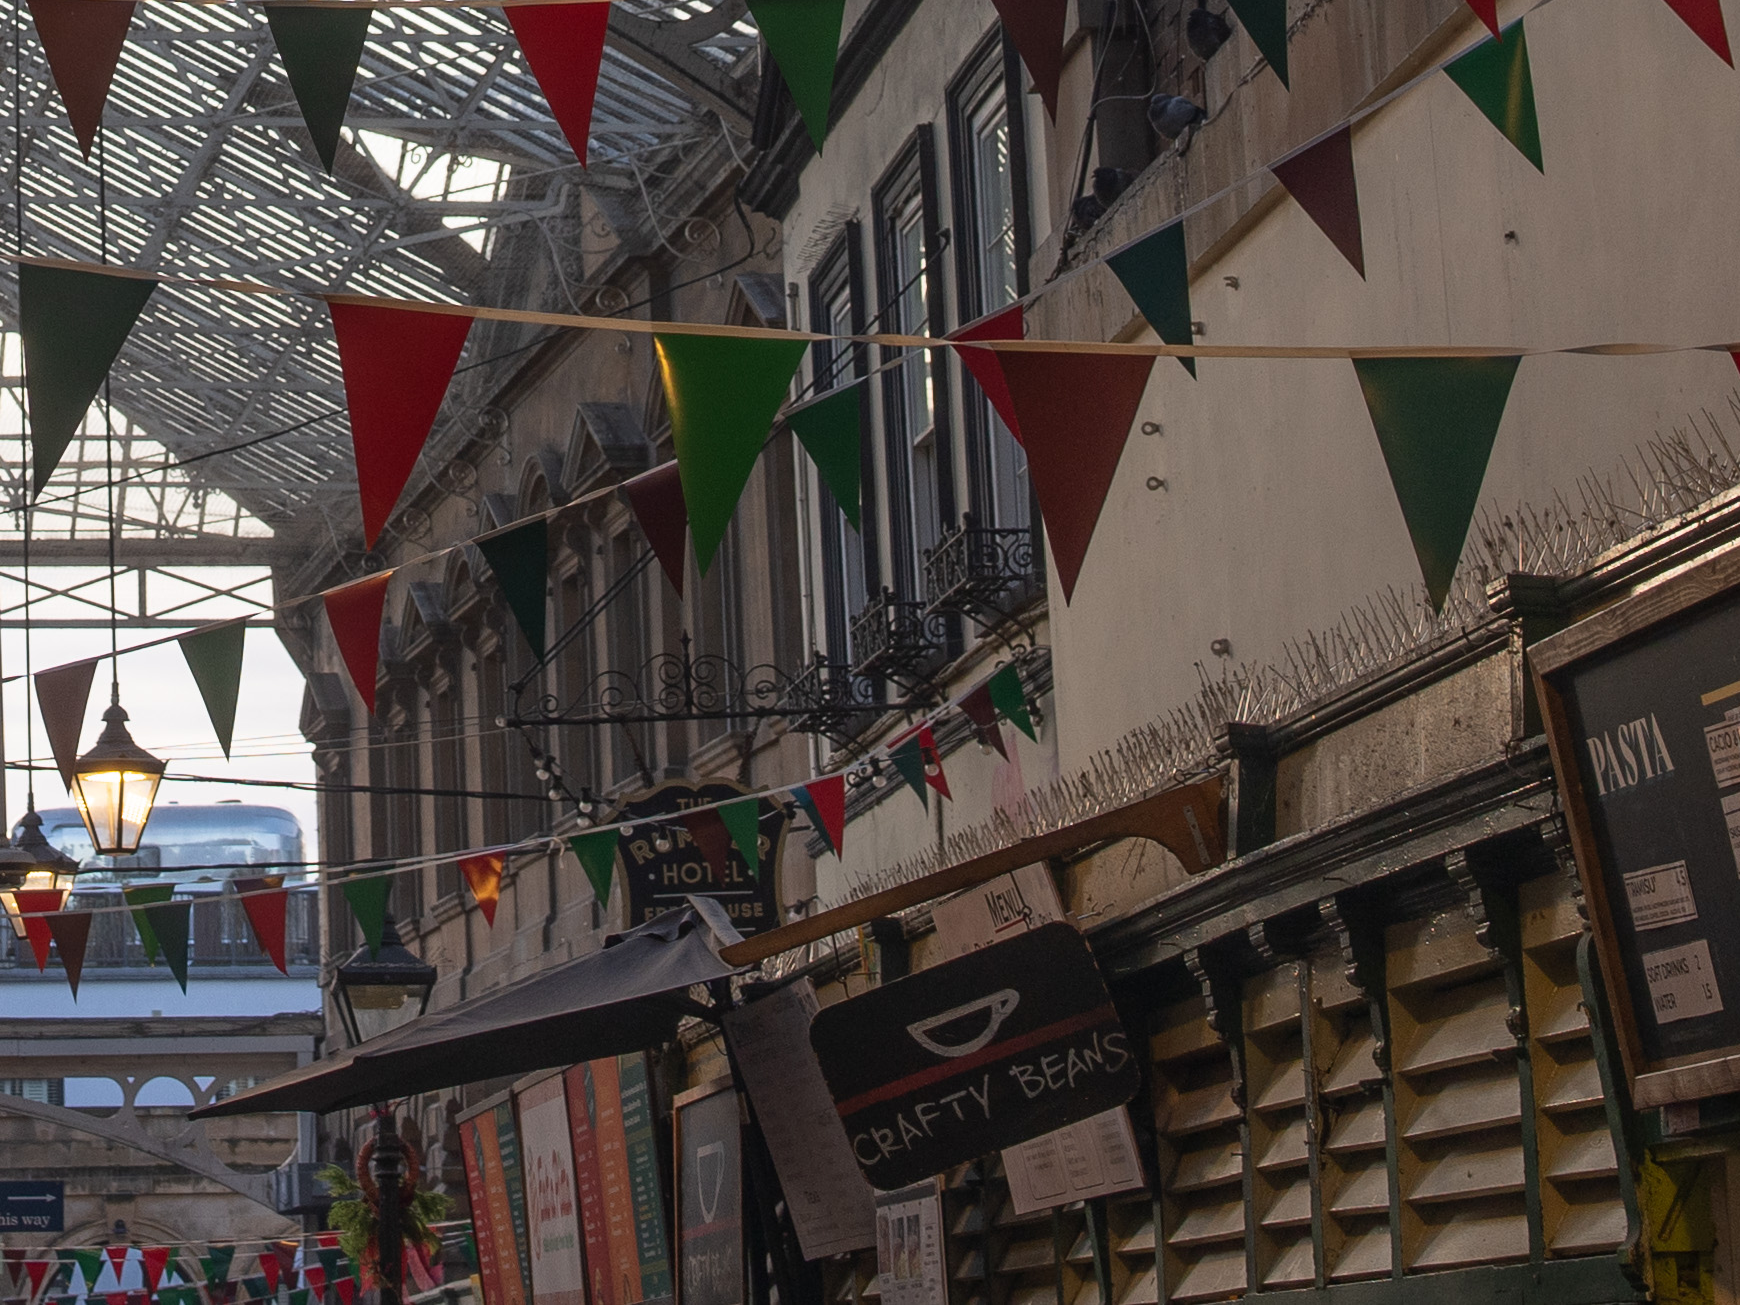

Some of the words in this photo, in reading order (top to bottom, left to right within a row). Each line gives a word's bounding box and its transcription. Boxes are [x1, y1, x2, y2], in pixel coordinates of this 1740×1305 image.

[1586, 712, 1675, 796] PASTA
[628, 829, 772, 867] RUMR
[984, 886, 1022, 928] MENU
[1646, 965, 1663, 984] SOFT
[1661, 957, 1690, 980] DRINKS
[1694, 954, 1702, 971] 2
[1653, 992, 1678, 1013] WATER
[852, 1074, 992, 1166] CRAFTY
[1008, 1030, 1130, 1099] BEANS
[22, 1215, 51, 1228] way
